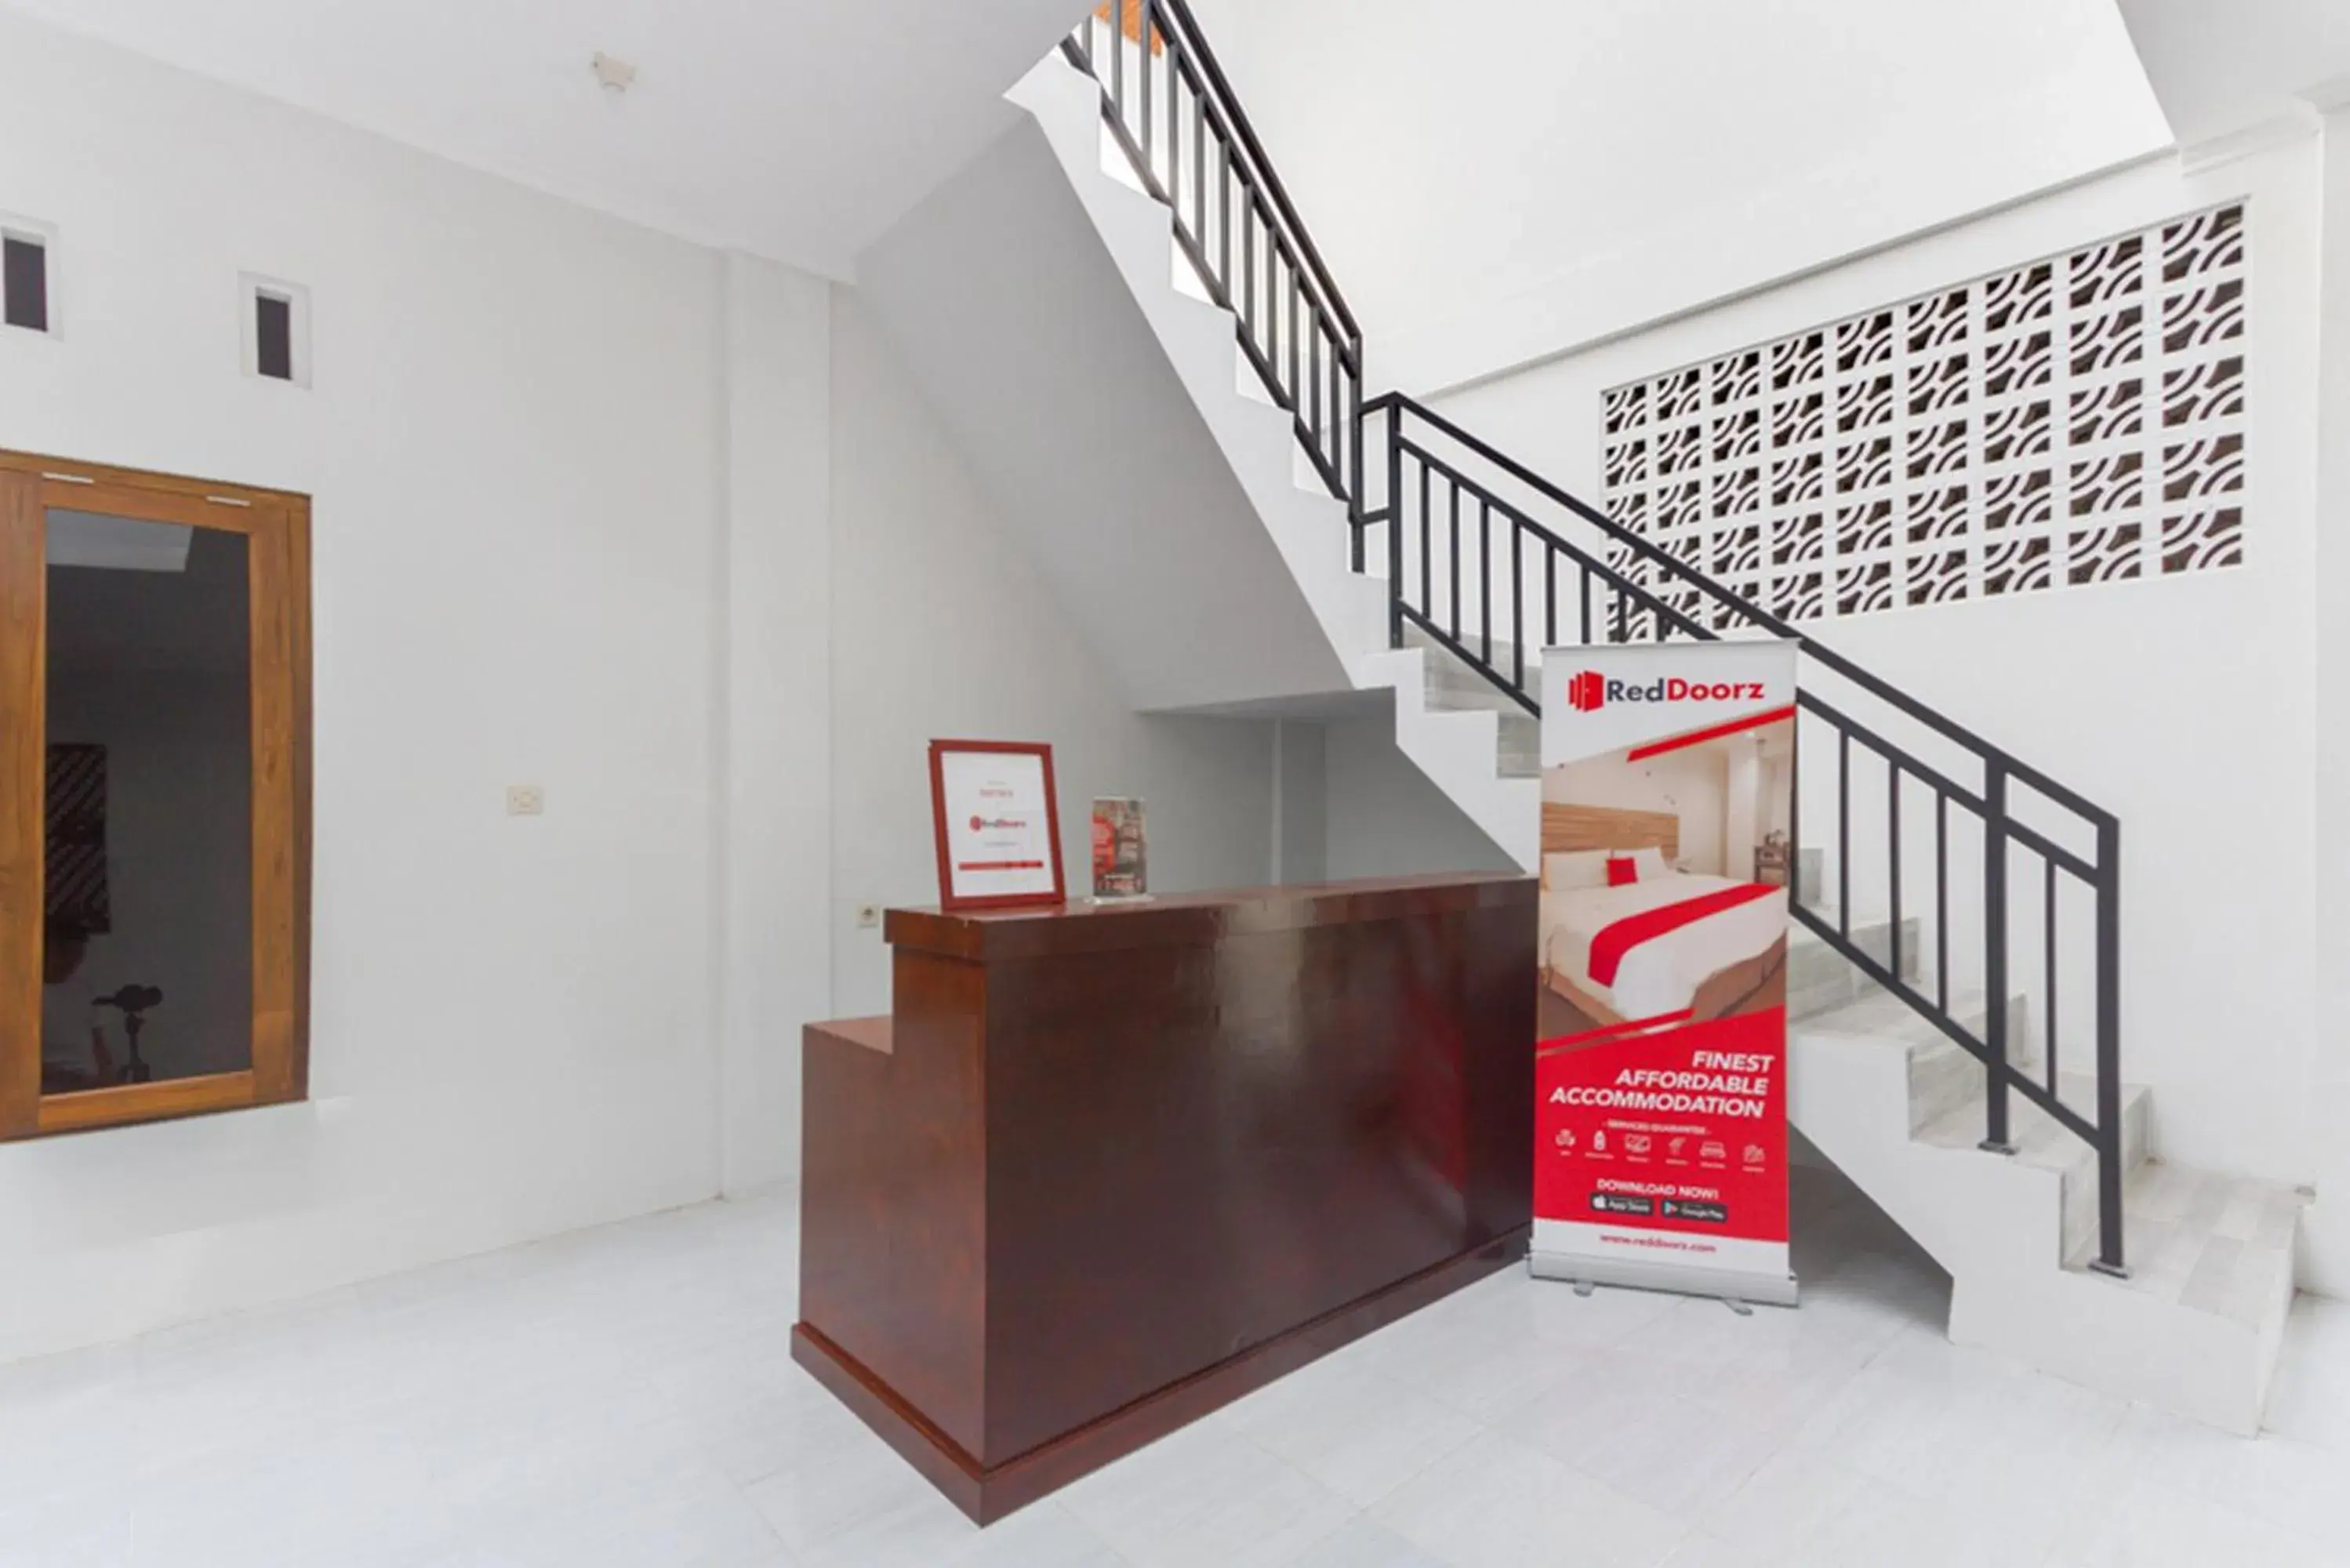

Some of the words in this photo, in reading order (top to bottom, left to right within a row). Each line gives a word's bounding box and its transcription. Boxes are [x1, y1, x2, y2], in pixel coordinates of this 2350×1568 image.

[1607, 678, 1764, 702] RedDoorz
[1692, 1050, 1774, 1072] FINEST
[1615, 1069, 1768, 1095] AFFORDABLE
[1550, 1087, 1764, 1119] ACCOMMODATION
[1596, 1178, 1676, 1196] DOWNLOAD
[1679, 1185, 1720, 1200] NOW!
[1608, 1200, 1626, 1210] App
[1681, 1205, 1707, 1218] Google
